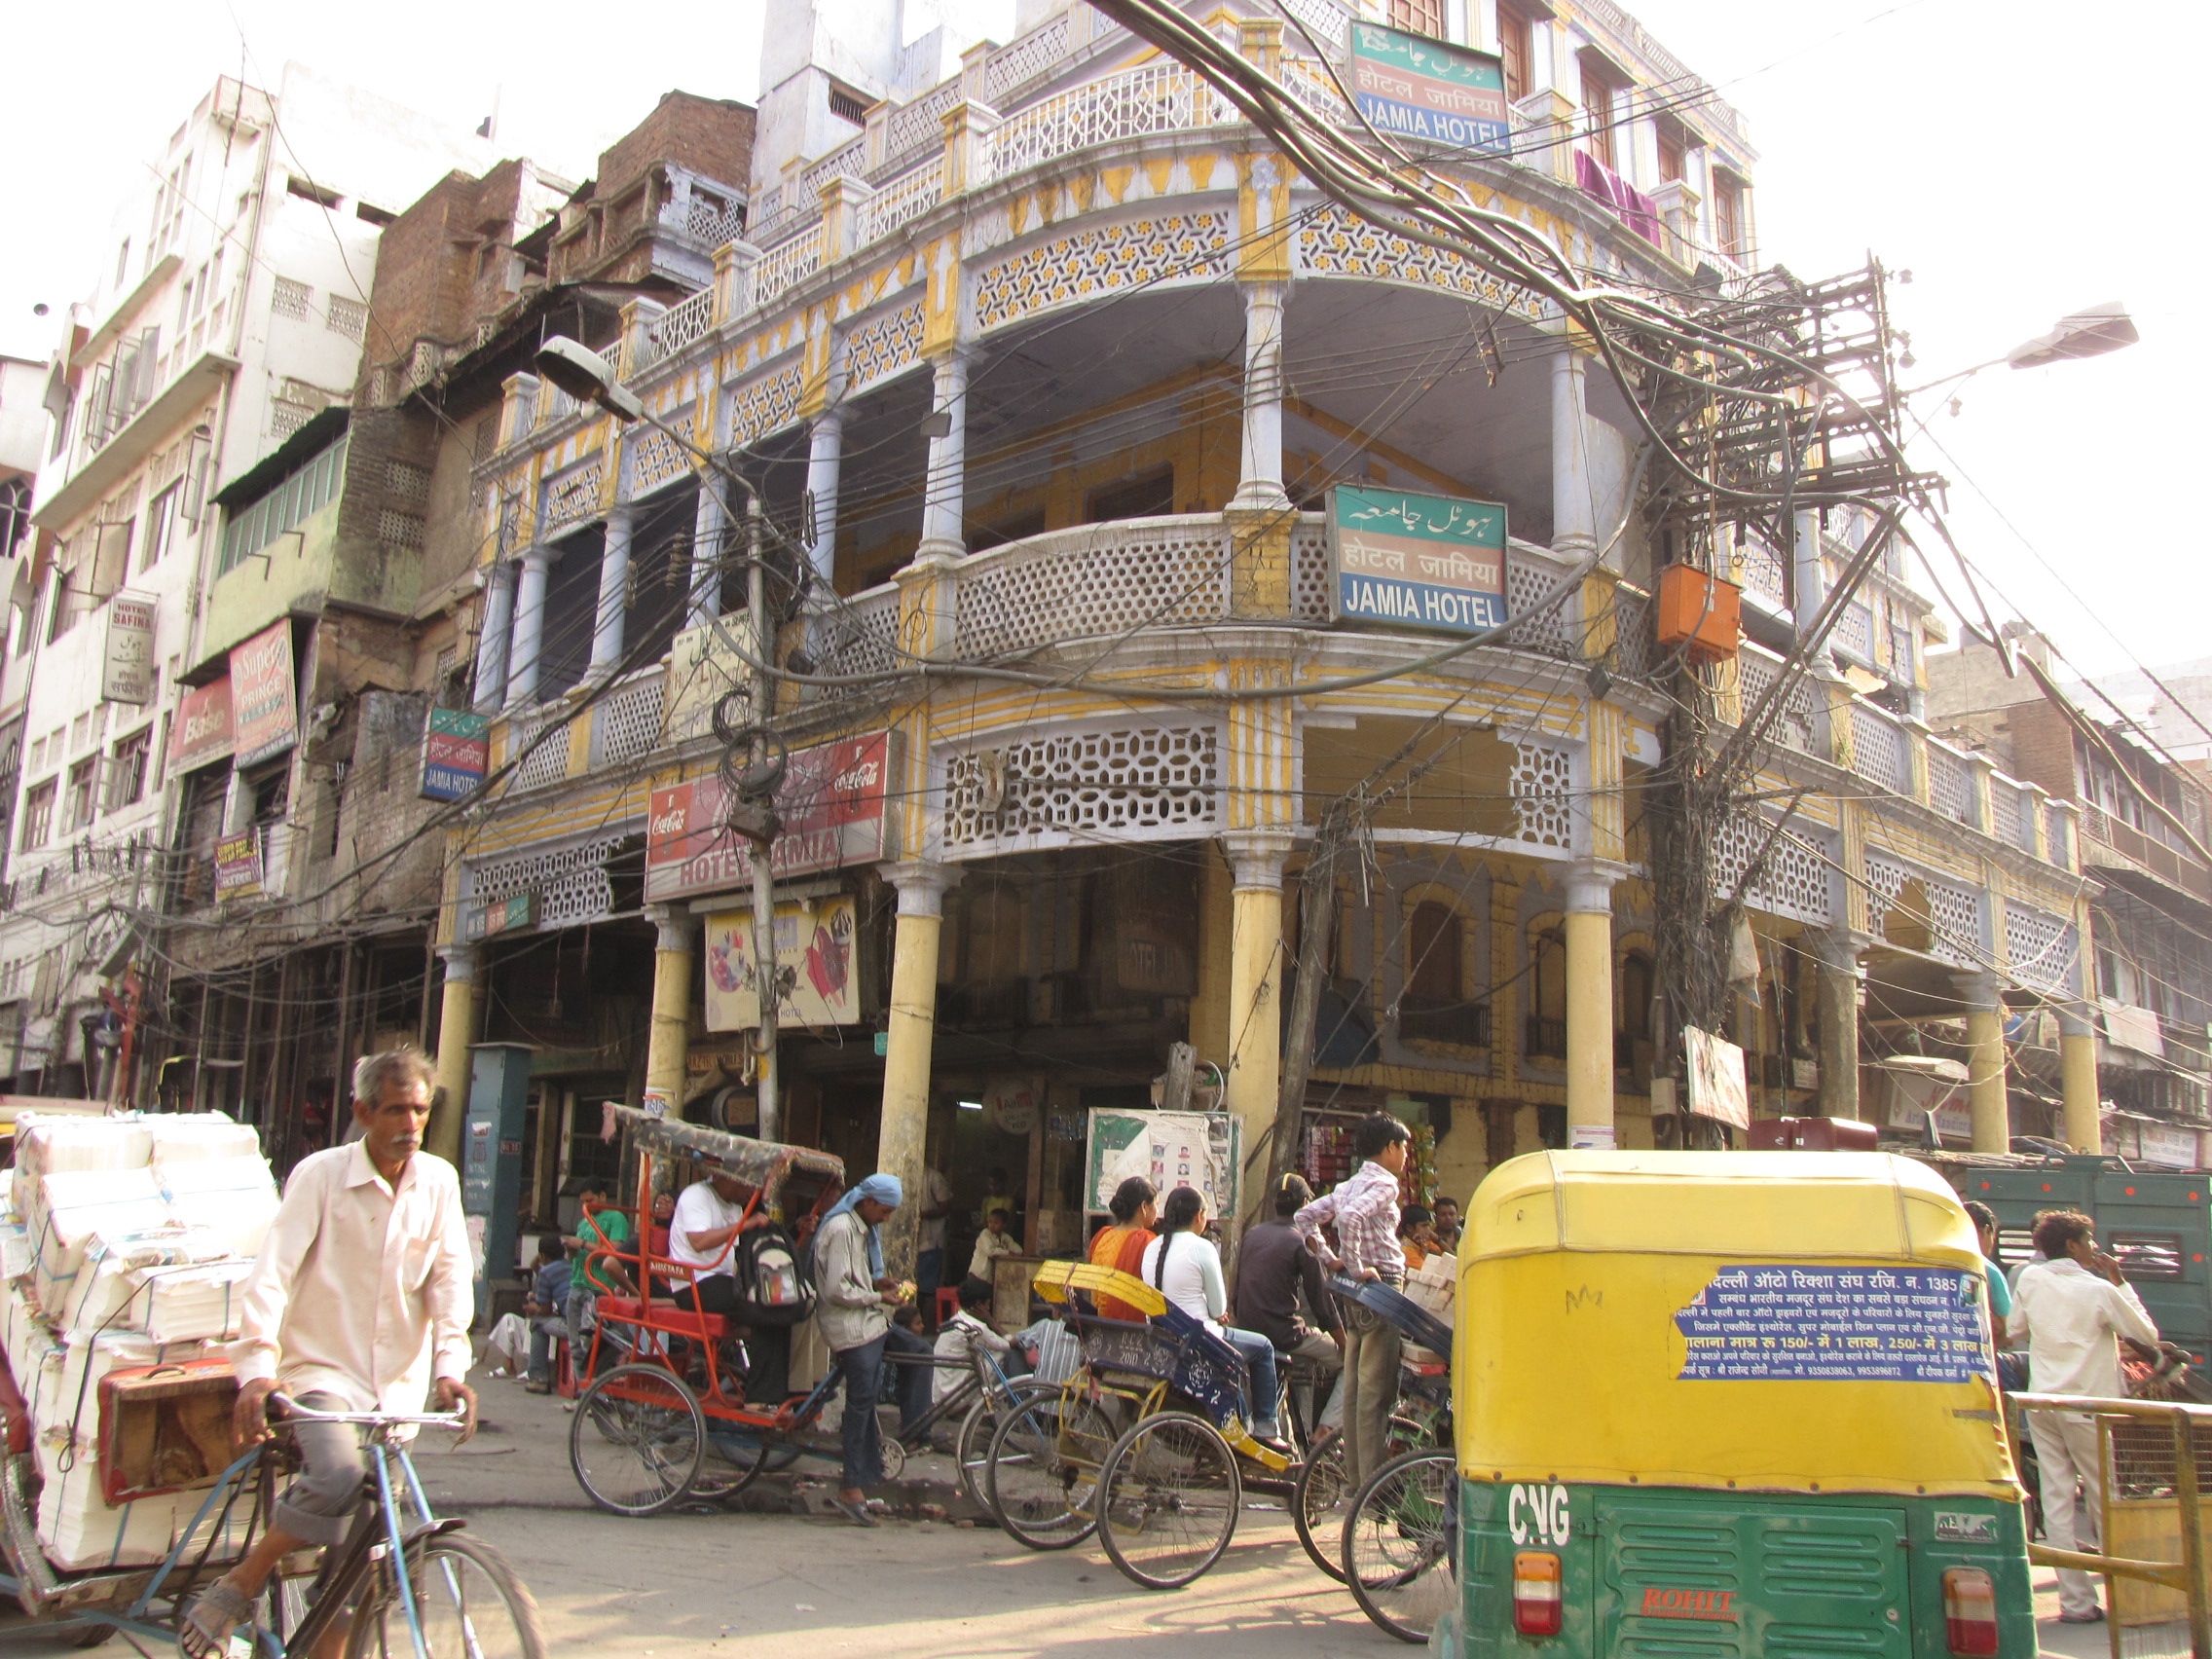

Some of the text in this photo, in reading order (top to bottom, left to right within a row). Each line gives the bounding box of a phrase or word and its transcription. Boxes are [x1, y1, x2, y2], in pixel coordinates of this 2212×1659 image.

[1357, 65, 1500, 118] होटल जामिया
[1361, 97, 1506, 150] JAMIA HOTEL
[1342, 536, 1498, 584] होटल जामिया
[118, 604, 148, 614] HOTEL
[1346, 580, 1504, 628] JAMIA HOTEL
[114, 613, 152, 629] SAFINA
[242, 641, 279, 683] Super
[241, 675, 281, 709] PRINCE
[426, 768, 478, 795] JAMIA HOTEL
[834, 760, 880, 793] Coca-Cola
[651, 808, 686, 836] Coca-Cola
[680, 830, 838, 887] HOTEL AMIA
[650, 1261, 684, 1275] MUSTAFA
[1753, 1270, 1788, 1288] ऑटो
[1791, 1269, 1833, 1288] रिक्शा
[1837, 1271, 1863, 1288] संघ
[1867, 1270, 1900, 1289] रजि.
[1927, 1276, 1958, 1292] 1385
[1750, 1290, 1784, 1305] भारतीय
[1817, 1291, 1833, 1305] संघ
[1835, 1290, 1851, 1305] देश
[1853, 1293, 1865, 1305] का
[1867, 1290, 1892, 1305] सबसे
[1711, 1306, 1734, 1318] पहली
[1851, 1306, 1861, 1317] के
[1797, 1323, 1817, 1335] सुपर
[1854, 1320, 1873, 1332] सिम
[1728, 1336, 1758, 1348] मात्र
[1780, 1336, 1814, 1349] 150/-
[1816, 1332, 1831, 1349] में
[1835, 1337, 1843, 1349] 1
[1846, 1336, 1884, 1351] लाख,
[1888, 1337, 1922, 1350] 250/-
[1923, 1334, 1936, 1350] में
[1940, 1340, 1949, 1351] 3
[1951, 1339, 1978, 1353] लाख
[1508, 1483, 1571, 1546] CNG
[1641, 1587, 1739, 1612] ROHIT
